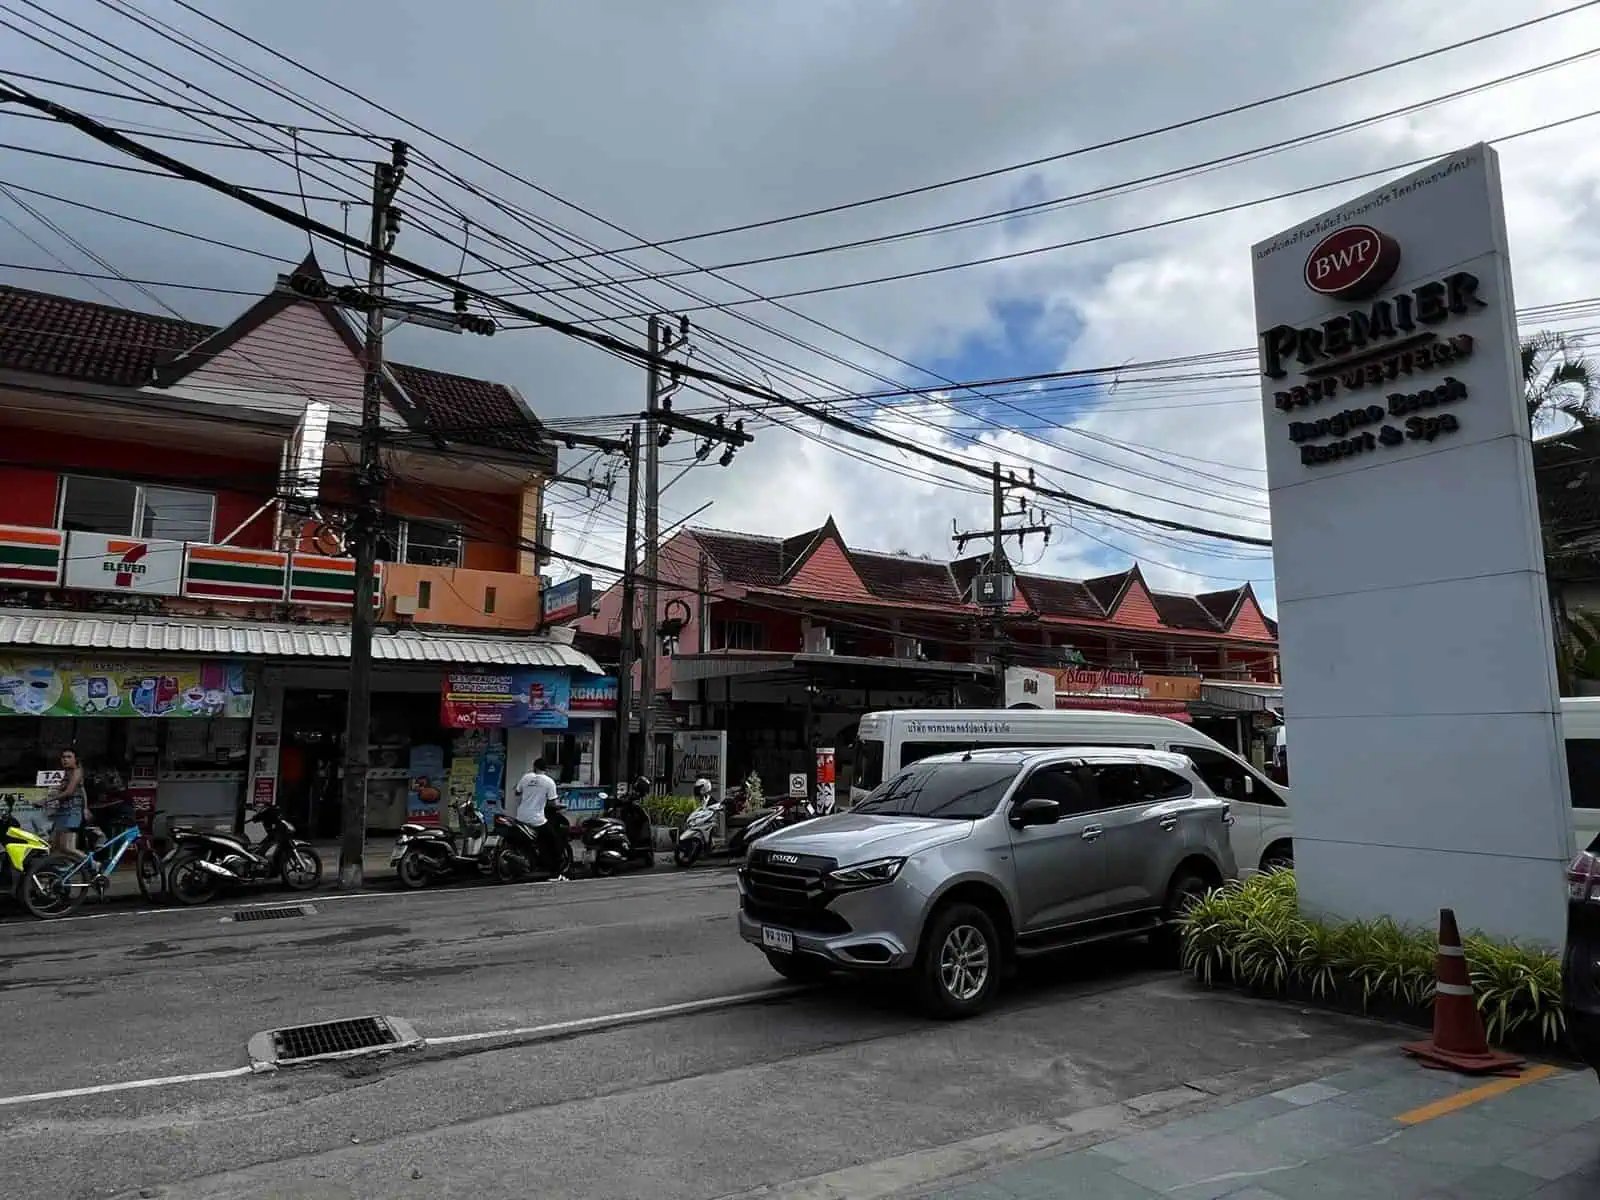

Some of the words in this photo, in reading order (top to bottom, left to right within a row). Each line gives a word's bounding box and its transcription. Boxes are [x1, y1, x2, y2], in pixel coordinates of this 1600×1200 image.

[1314, 239, 1372, 280] BWP
[1260, 272, 1488, 377] PREMIER
[107, 540, 147, 586] 7
[570, 687, 618, 701] XCHAN
[44, 771, 62, 780] TA
[772, 853, 799, 864] ISUZU
